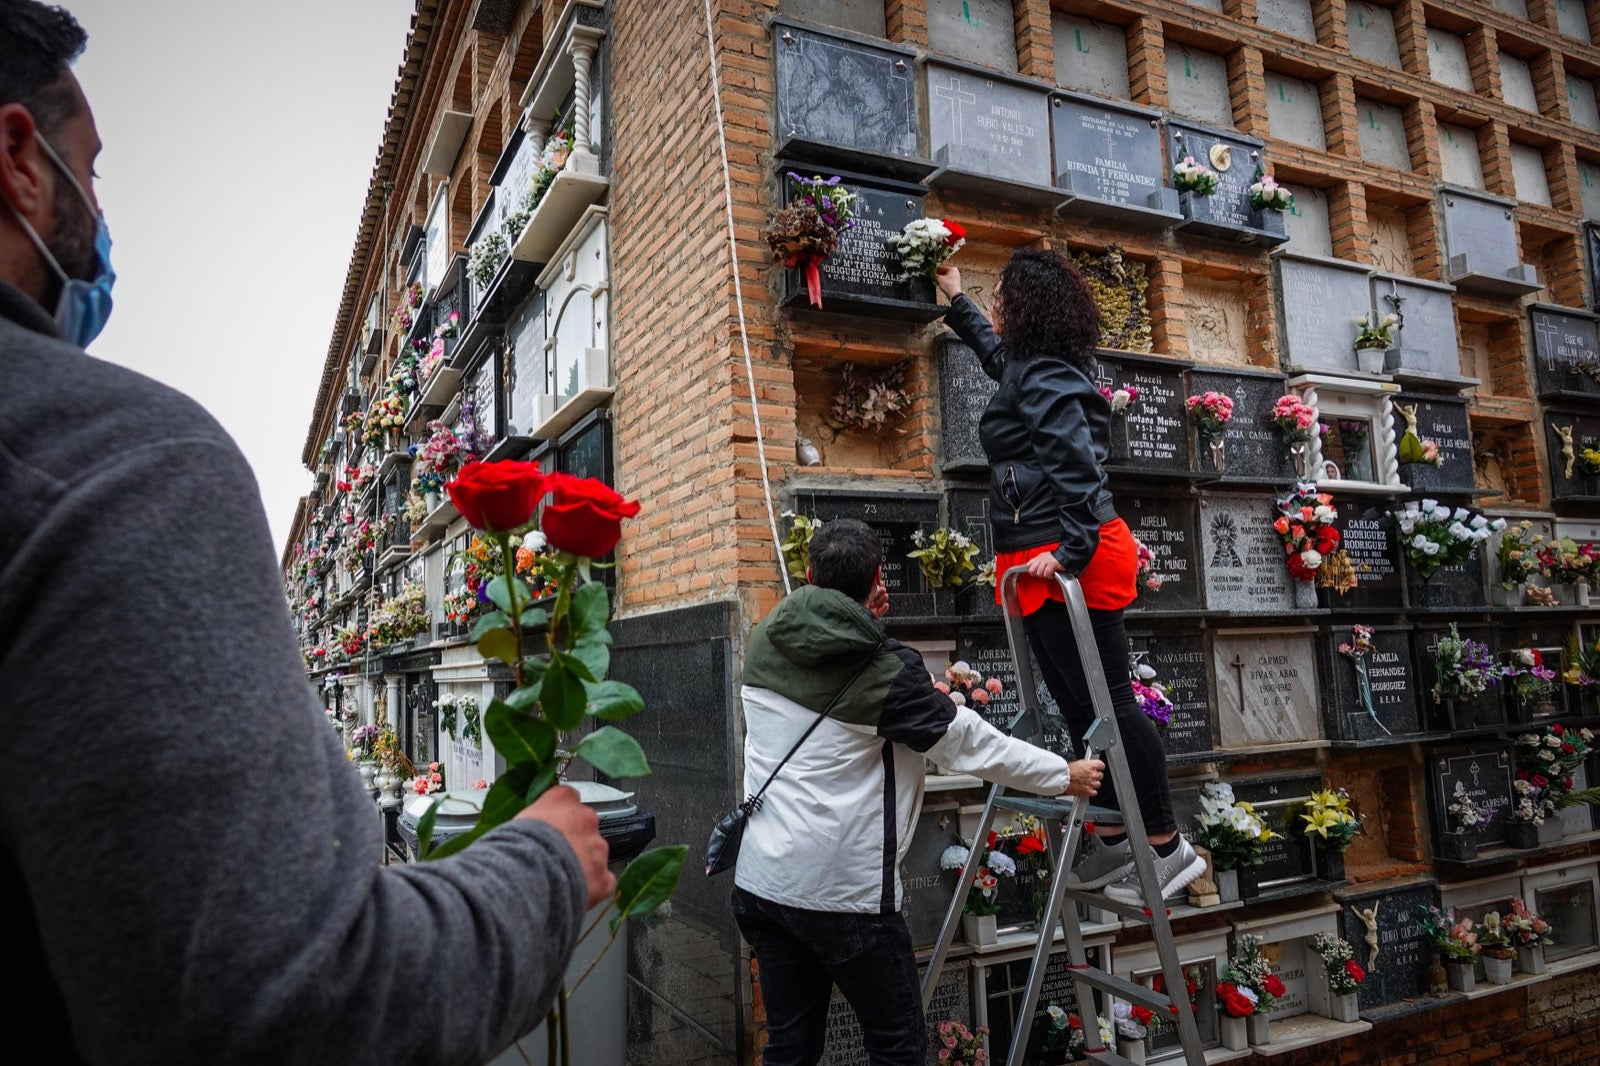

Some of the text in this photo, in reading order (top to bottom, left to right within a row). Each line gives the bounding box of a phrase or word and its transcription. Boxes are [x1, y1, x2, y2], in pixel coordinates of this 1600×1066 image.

[991, 104, 1021, 121] ANTONIO
[977, 115, 1035, 138] RUBIO VALLEJO
[1095, 157, 1128, 172] FAMILIA
[1067, 160, 1157, 187] BIENDA Y FERNANDEZ
[850, 217, 881, 230] NTONIO
[852, 239, 886, 251] TERESA
[863, 248, 900, 261] SEGOVIA
[854, 260, 888, 273] TERESA
[862, 269, 902, 282] GONZALE
[952, 377, 1000, 392] DE LA TO
[1134, 372, 1162, 385] Araceli
[1152, 385, 1175, 397] Perea
[1157, 415, 1182, 428] Muñoz
[1432, 422, 1453, 434] FAMILIA
[1129, 439, 1177, 451] VUESTRA FAMILIA
[1444, 438, 1454, 449] LAS
[1454, 439, 1470, 450] HERAS
[1133, 448, 1143, 456] NO
[864, 503, 877, 514] 73
[1140, 516, 1168, 528] AURELIA
[1348, 519, 1380, 530] CARLOS
[1133, 530, 1185, 543] ERRERO TOMAS
[1343, 529, 1387, 541] RODRIGUEZ
[1148, 544, 1172, 556] RAMON
[1344, 539, 1388, 551] RODRIGUEZ
[1164, 556, 1188, 571] MUÑOZ
[978, 649, 1011, 660] LORENZ
[1156, 652, 1204, 664] NAVARRETE
[1258, 655, 1289, 666] CARMEN
[1372, 652, 1400, 663] FAMILIA
[992, 661, 1014, 672] CEPE
[1172, 667, 1178, 676] Y
[1368, 667, 1406, 677] FERNANDEZ
[1250, 669, 1298, 680] RIVAS ABAD
[1169, 676, 1198, 689] MUÑOZ
[1371, 681, 1407, 691] RODRIGUEZ
[989, 690, 1017, 701] ARLOS
[993, 702, 1020, 714] JIMEN
[1177, 712, 1191, 720] VIDA
[1044, 734, 1057, 743] LIA
[902, 874, 941, 890] RTINEZ
[1043, 980, 1073, 992] ENCARNAC
